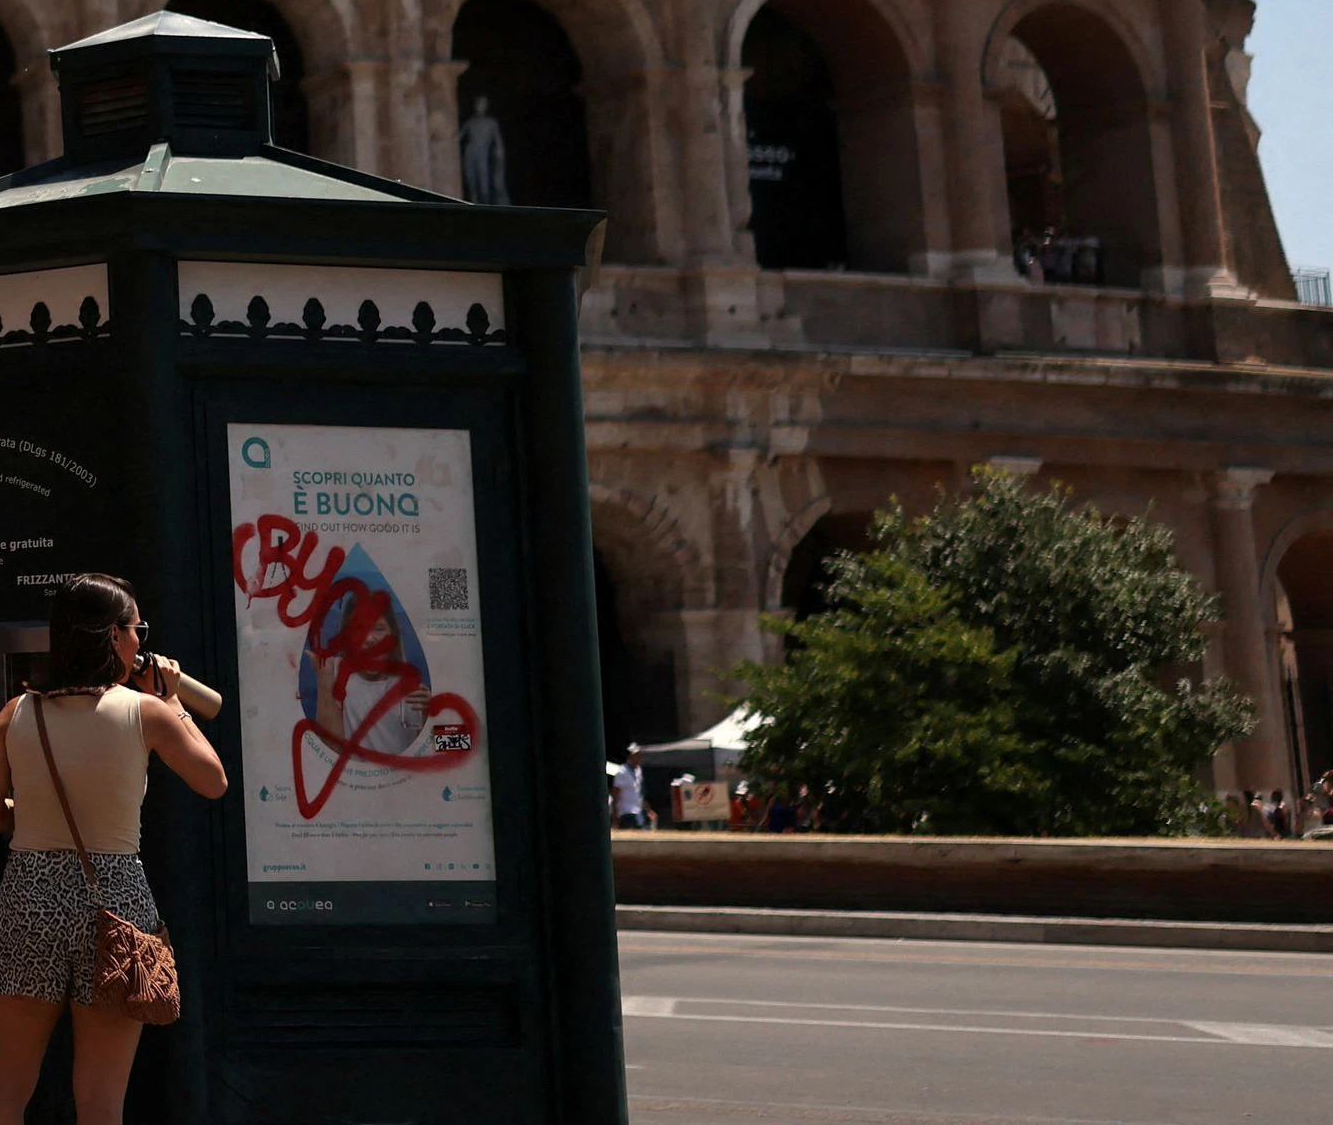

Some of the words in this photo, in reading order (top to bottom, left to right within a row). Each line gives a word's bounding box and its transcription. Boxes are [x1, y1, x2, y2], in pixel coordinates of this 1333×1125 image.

[18, 438, 47, 458] (DLgs
[48, 450, 98, 488] 181/2003)
[5, 475, 51, 497] refrigerated
[293, 471, 347, 485] SCOPRI
[351, 473, 415, 488] QUANTO
[293, 485, 308, 515] È
[321, 523, 340, 532] OUT
[342, 523, 366, 532] HOW
[369, 524, 400, 533] GOOD
[401, 524, 409, 533] IT
[412, 524, 421, 533] IS
[9, 537, 54, 553] gratuita
